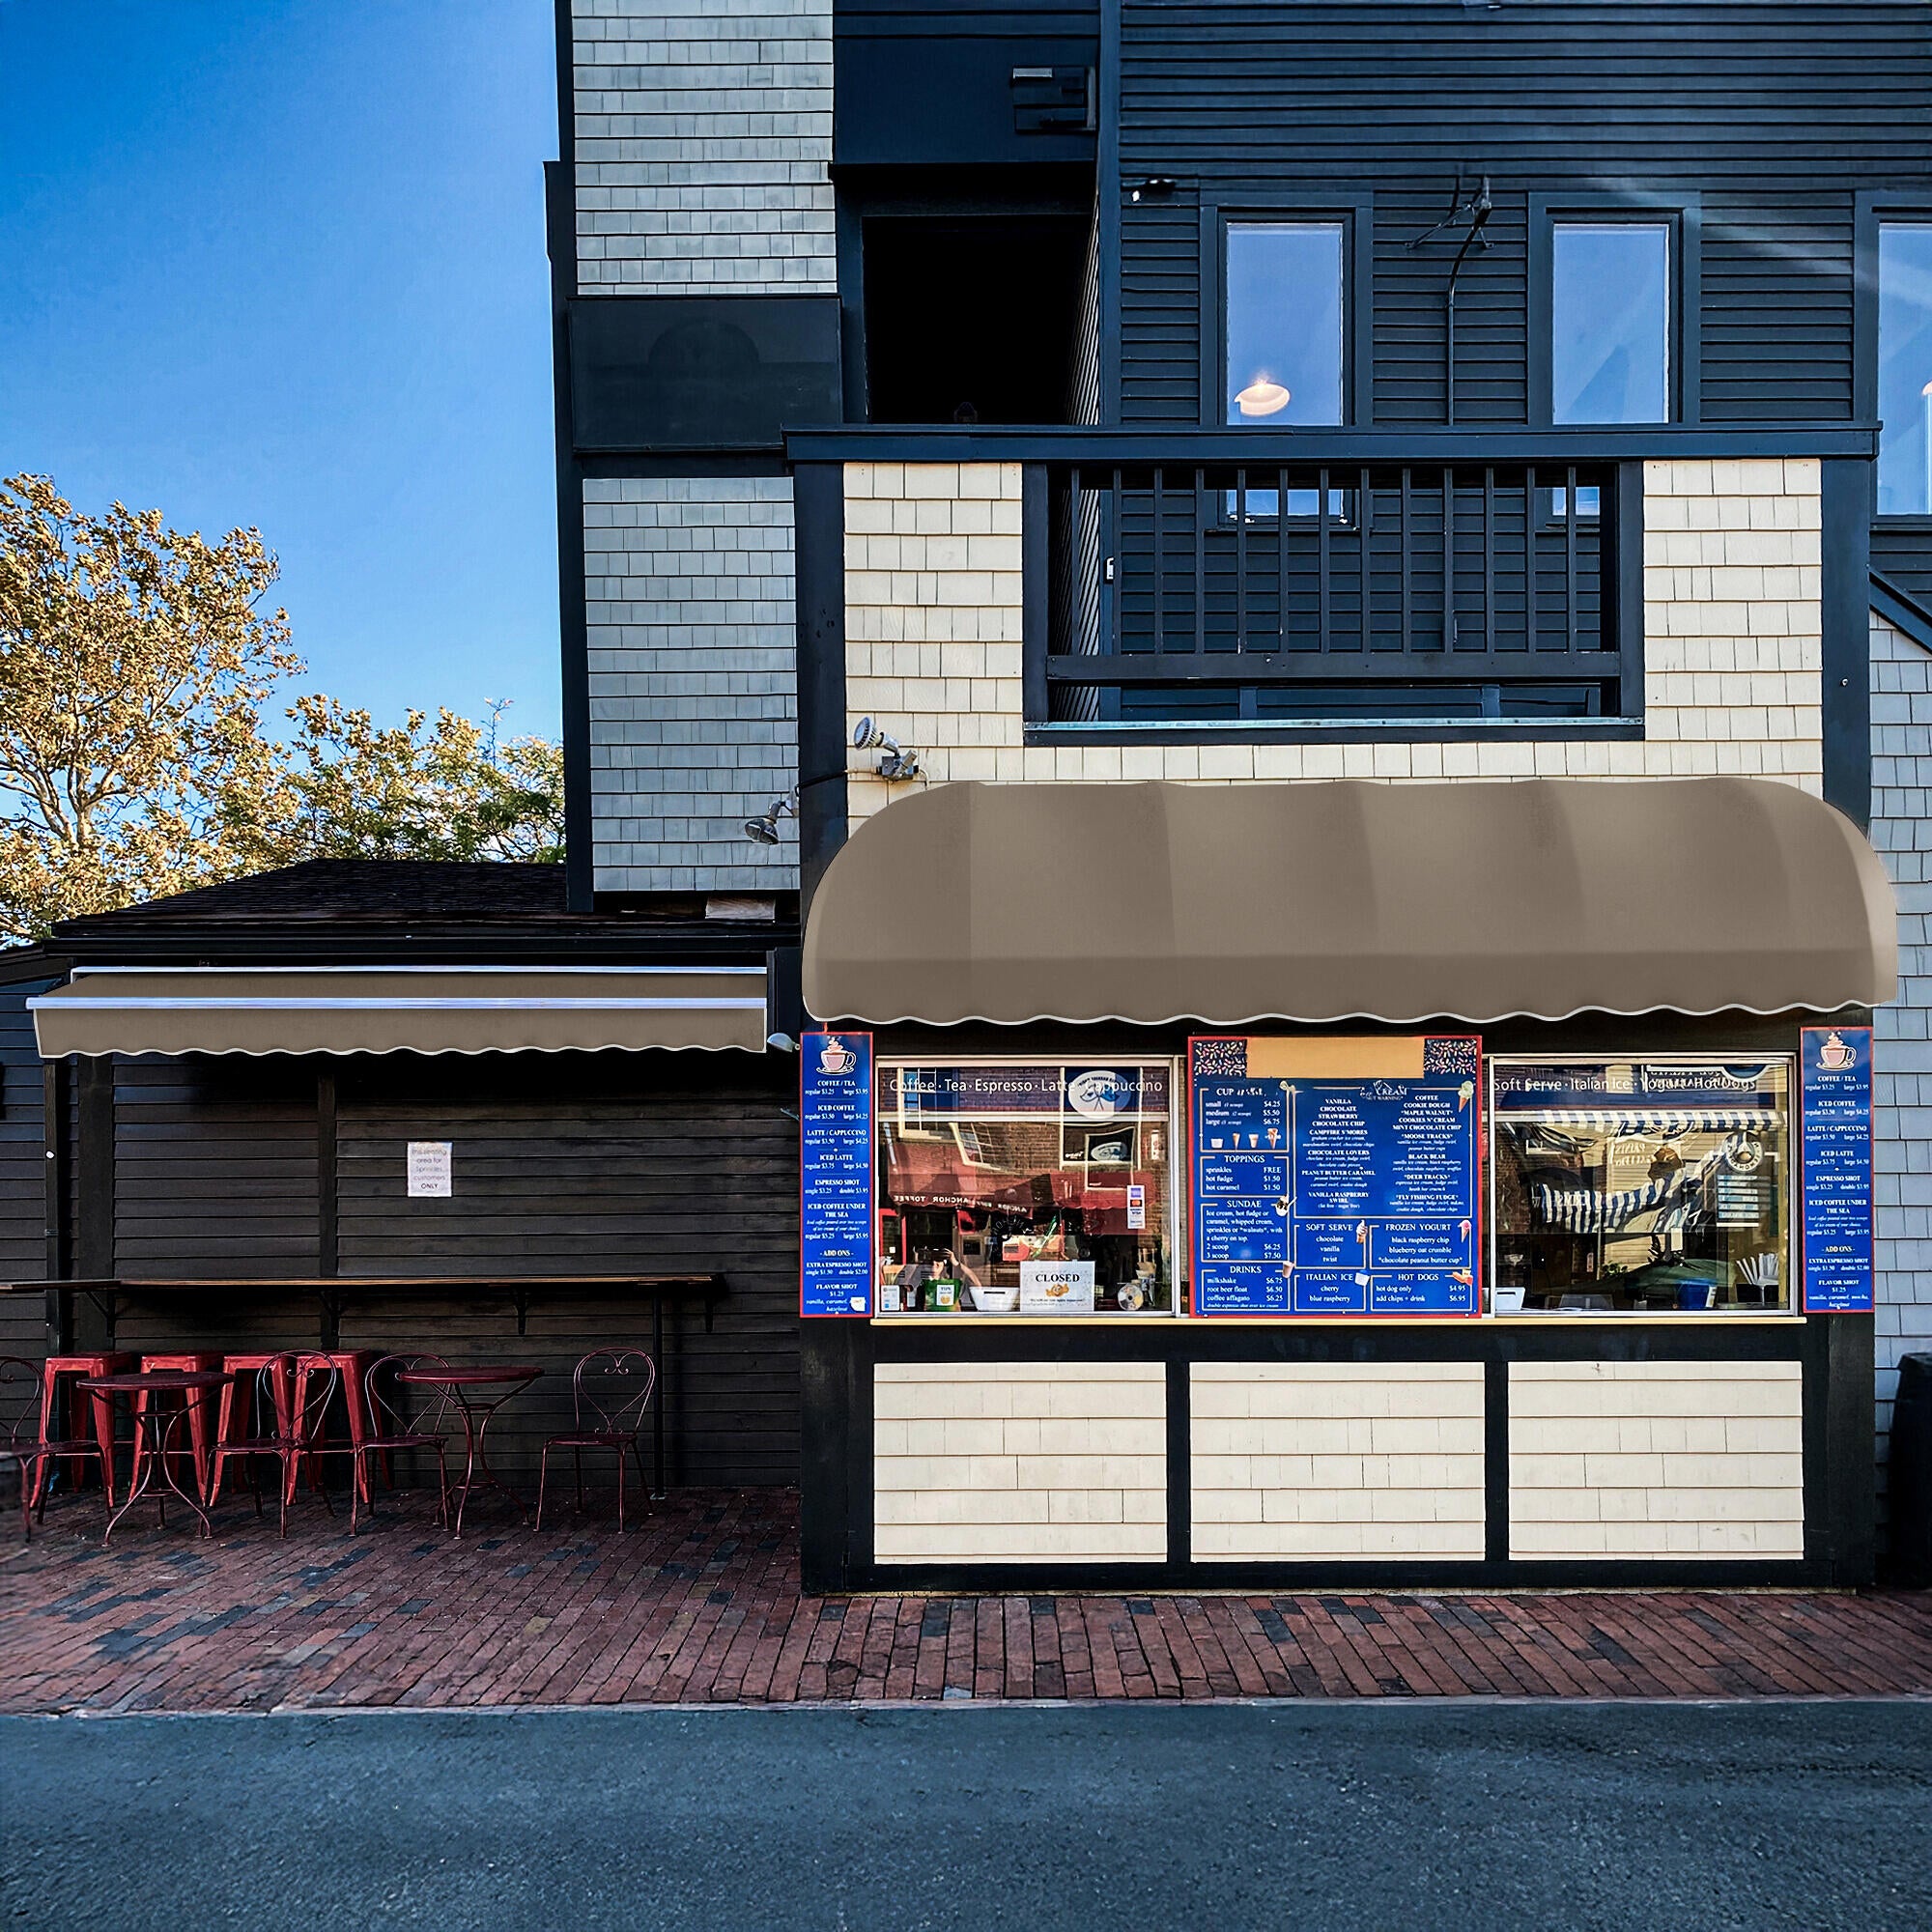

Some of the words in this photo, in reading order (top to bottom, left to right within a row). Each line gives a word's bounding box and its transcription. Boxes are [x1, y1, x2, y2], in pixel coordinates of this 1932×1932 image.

[890, 1079, 935, 1093] Coffee
[944, 1079, 967, 1092] Tea
[975, 1079, 1033, 1094] Espresso
[1493, 1079, 1520, 1091] Soft
[1525, 1078, 1562, 1091] Serve
[1571, 1078, 1608, 1091] Italian
[1612, 1078, 1630, 1091] Ice
[1230, 1265, 1262, 1274] DRINKS
